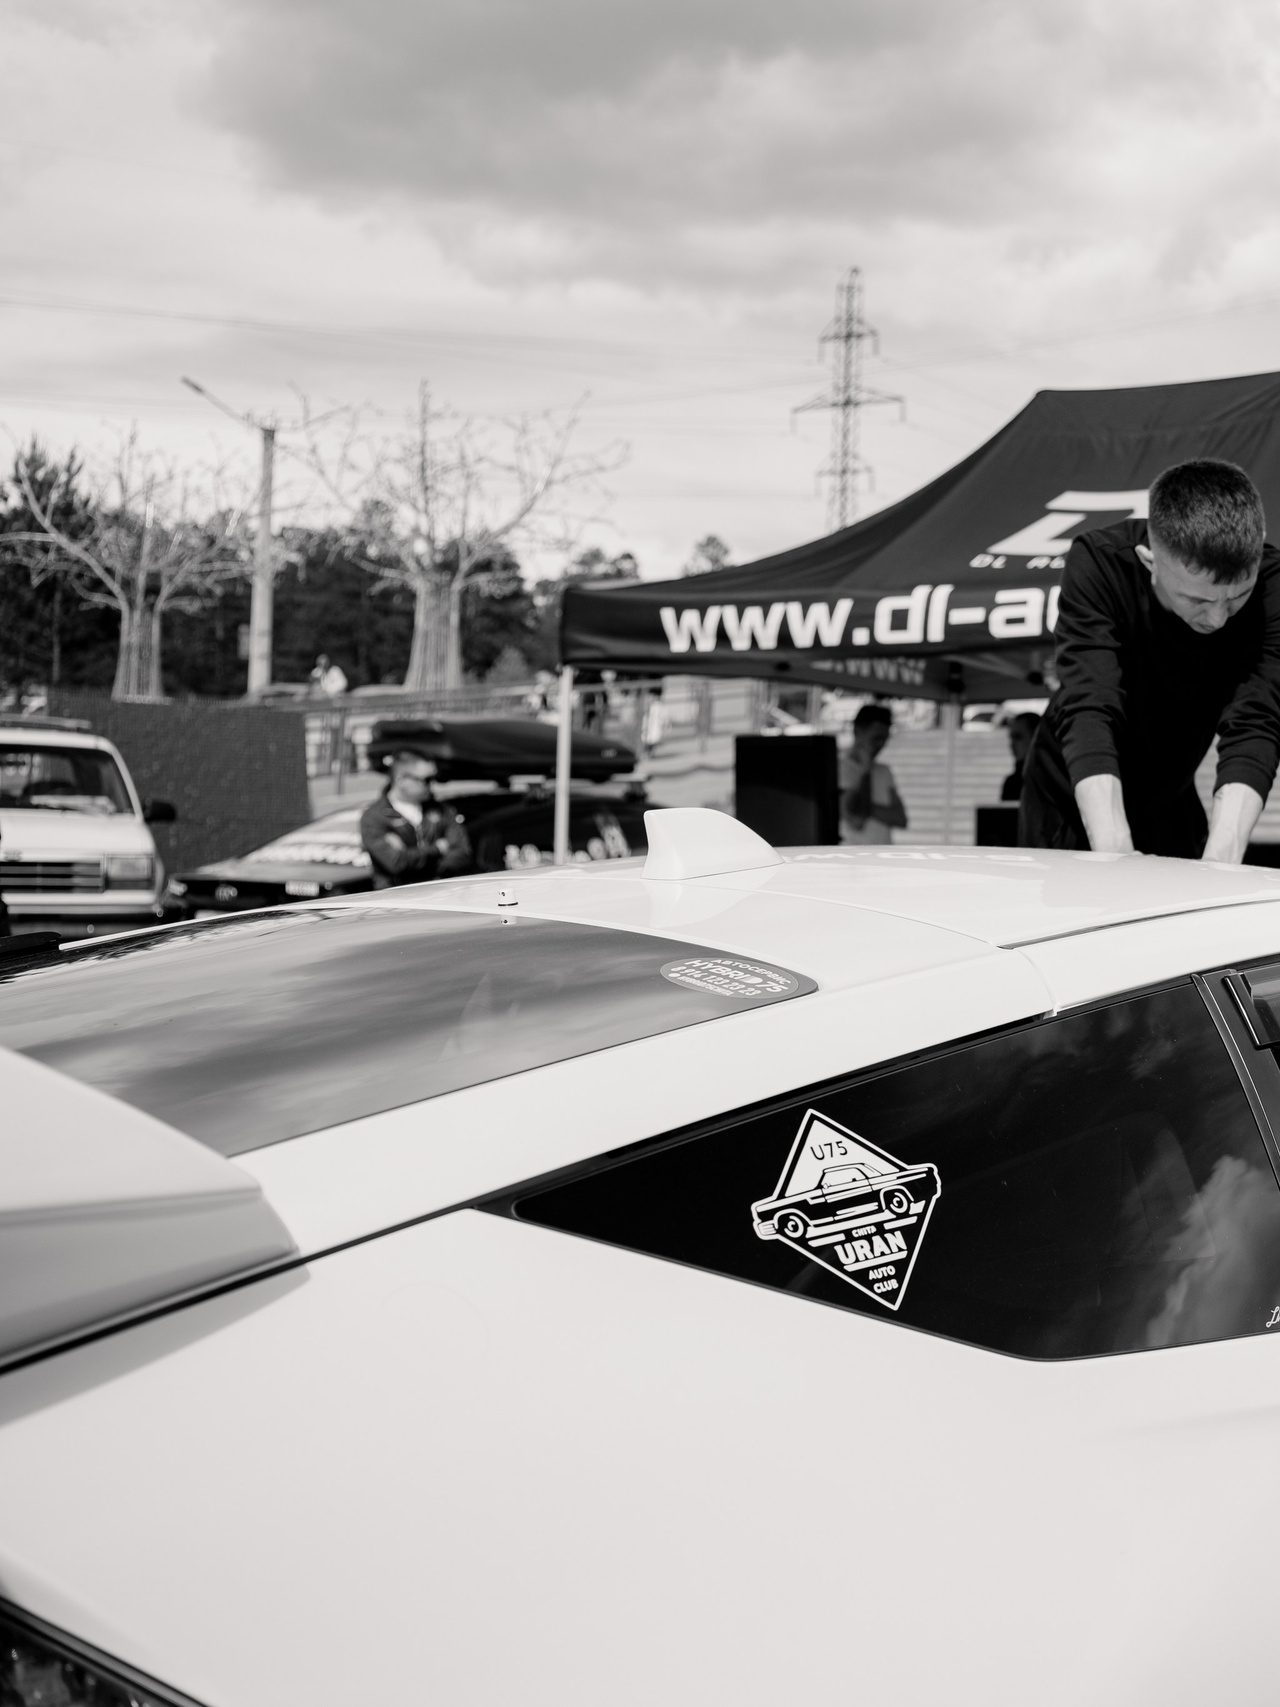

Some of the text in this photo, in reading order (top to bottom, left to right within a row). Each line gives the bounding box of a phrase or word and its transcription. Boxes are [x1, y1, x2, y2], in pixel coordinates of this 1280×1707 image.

[810, 1141, 848, 1160] U75
[833, 1231, 907, 1265] URAN
[868, 1265, 896, 1281] AUTO
[873, 1279, 899, 1294] CLUB
